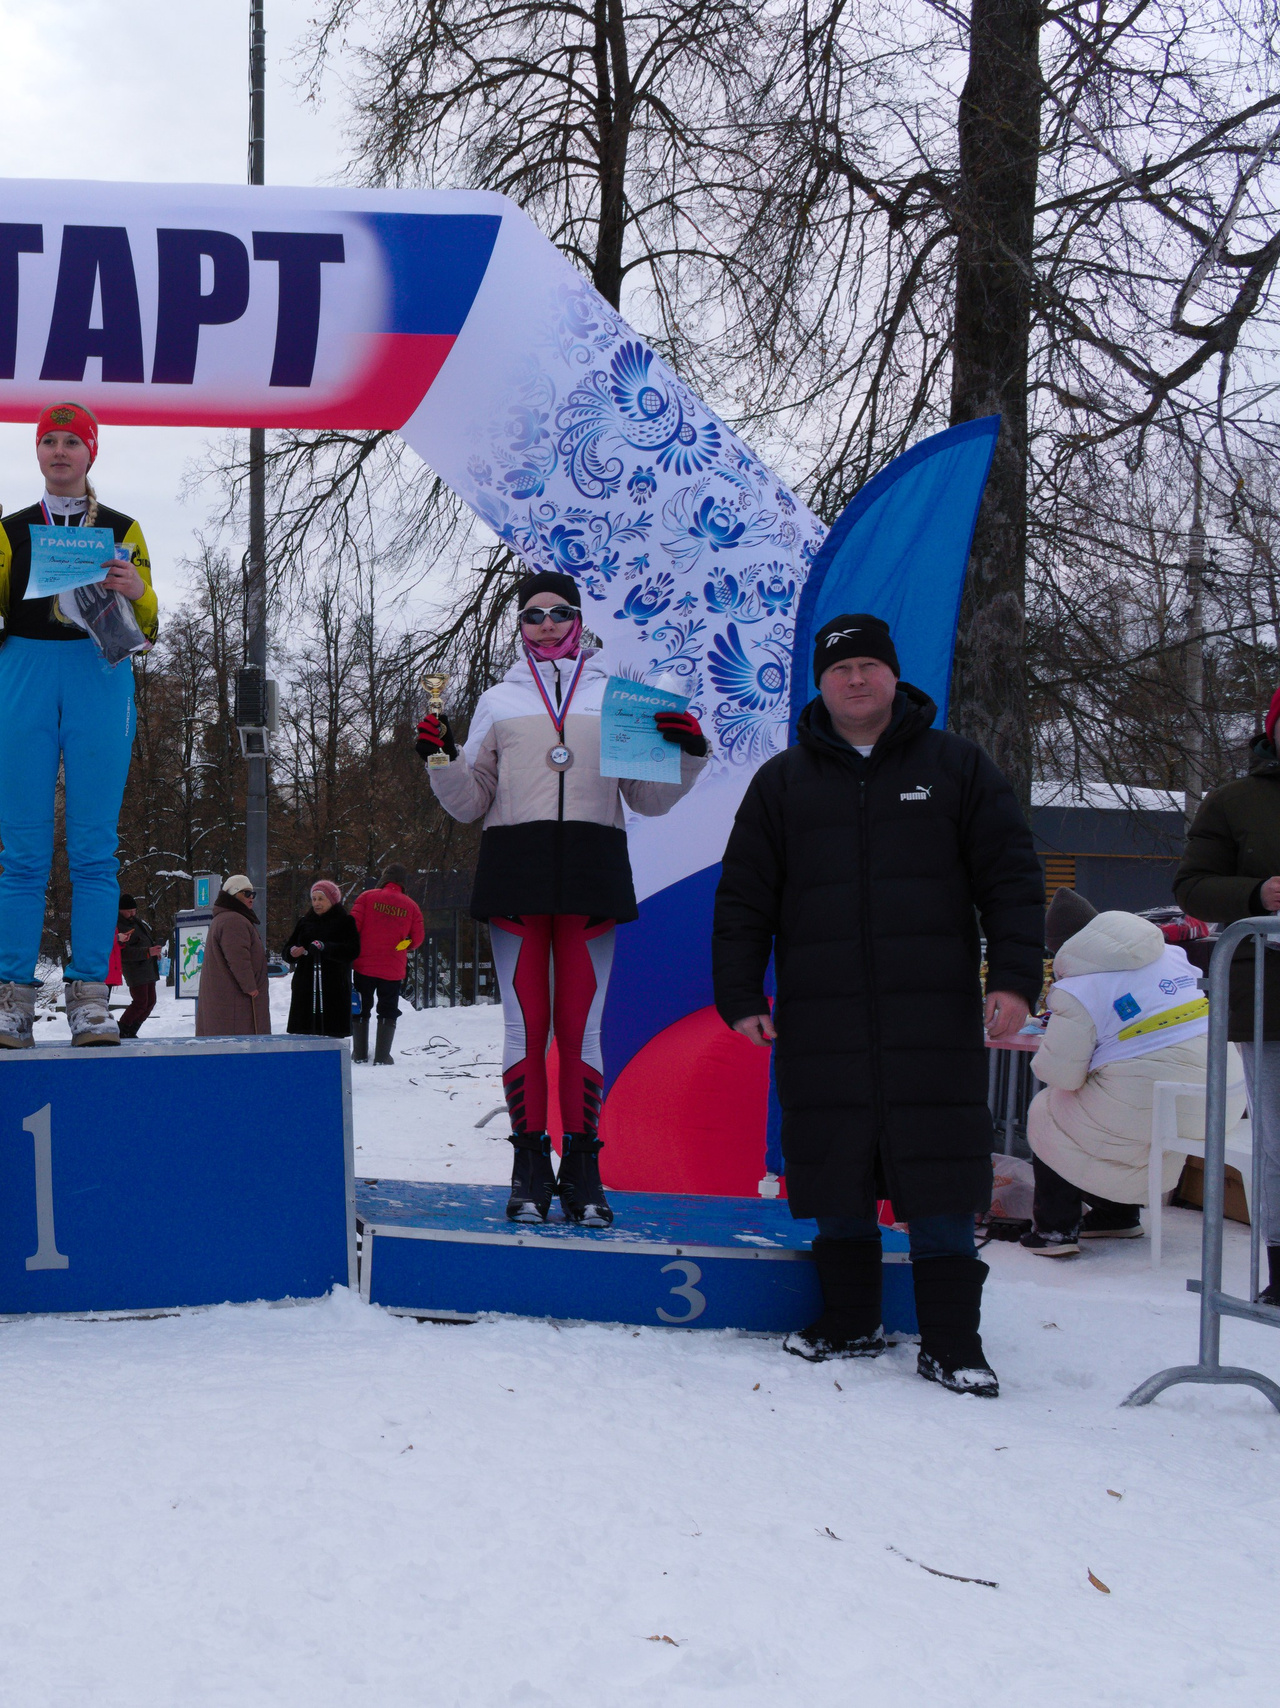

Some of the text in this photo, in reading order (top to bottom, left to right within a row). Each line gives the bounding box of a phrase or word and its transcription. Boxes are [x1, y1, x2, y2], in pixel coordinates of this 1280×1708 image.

[39, 538, 105, 549] ГРАМОТА
[611, 690, 677, 709] ГРАМОТА
[900, 792, 927, 801] PUMA
[373, 902, 408, 918] RUSSIA
[23, 1103, 68, 1271] 1
[656, 1260, 706, 1324] 3
